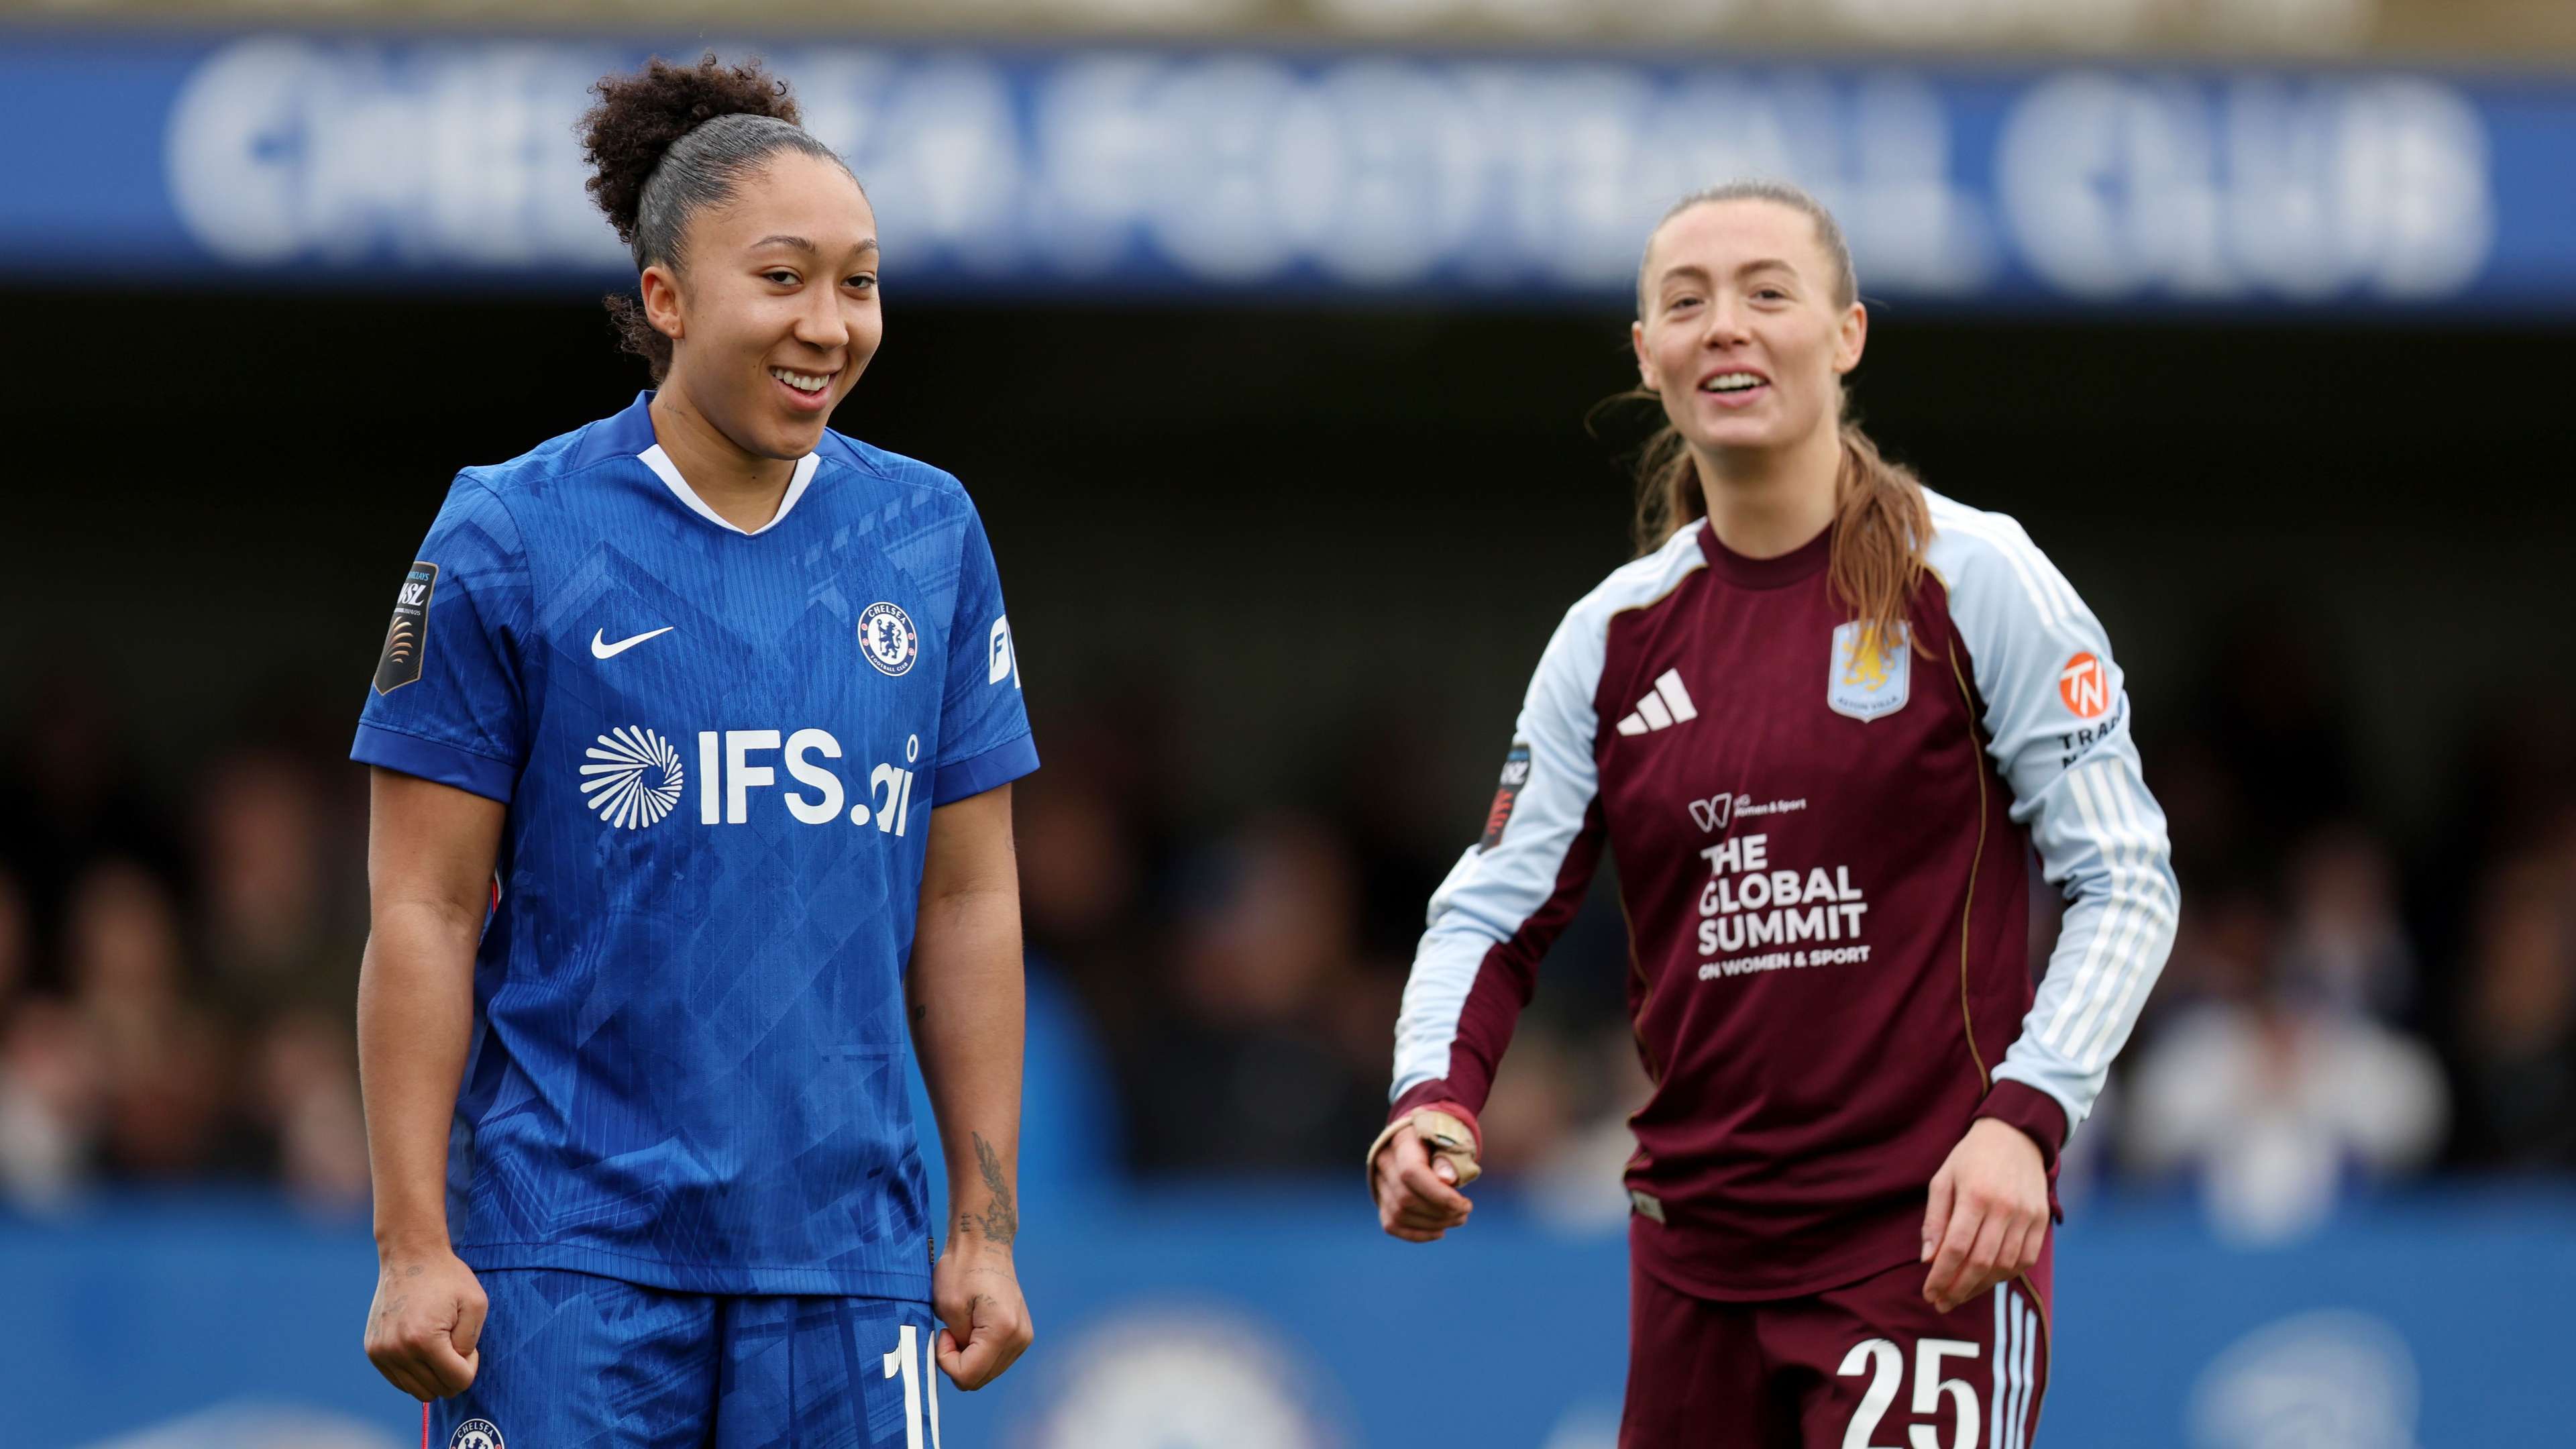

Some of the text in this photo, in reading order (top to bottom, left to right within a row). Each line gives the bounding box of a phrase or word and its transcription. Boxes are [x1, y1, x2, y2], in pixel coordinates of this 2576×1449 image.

[868, 605, 906, 625] CHELSEA
[870, 655, 908, 672] FOOTBALL CLUB
[1700, 834, 1768, 875] THE
[1699, 865, 1862, 917] GLOBAL
[1698, 903, 1868, 956] SUMMIT
[1698, 945, 1871, 981] ON WOMEN & SPORT
[1837, 1338, 1980, 1449] 25
[457, 1421, 493, 1438] CHELSEA
